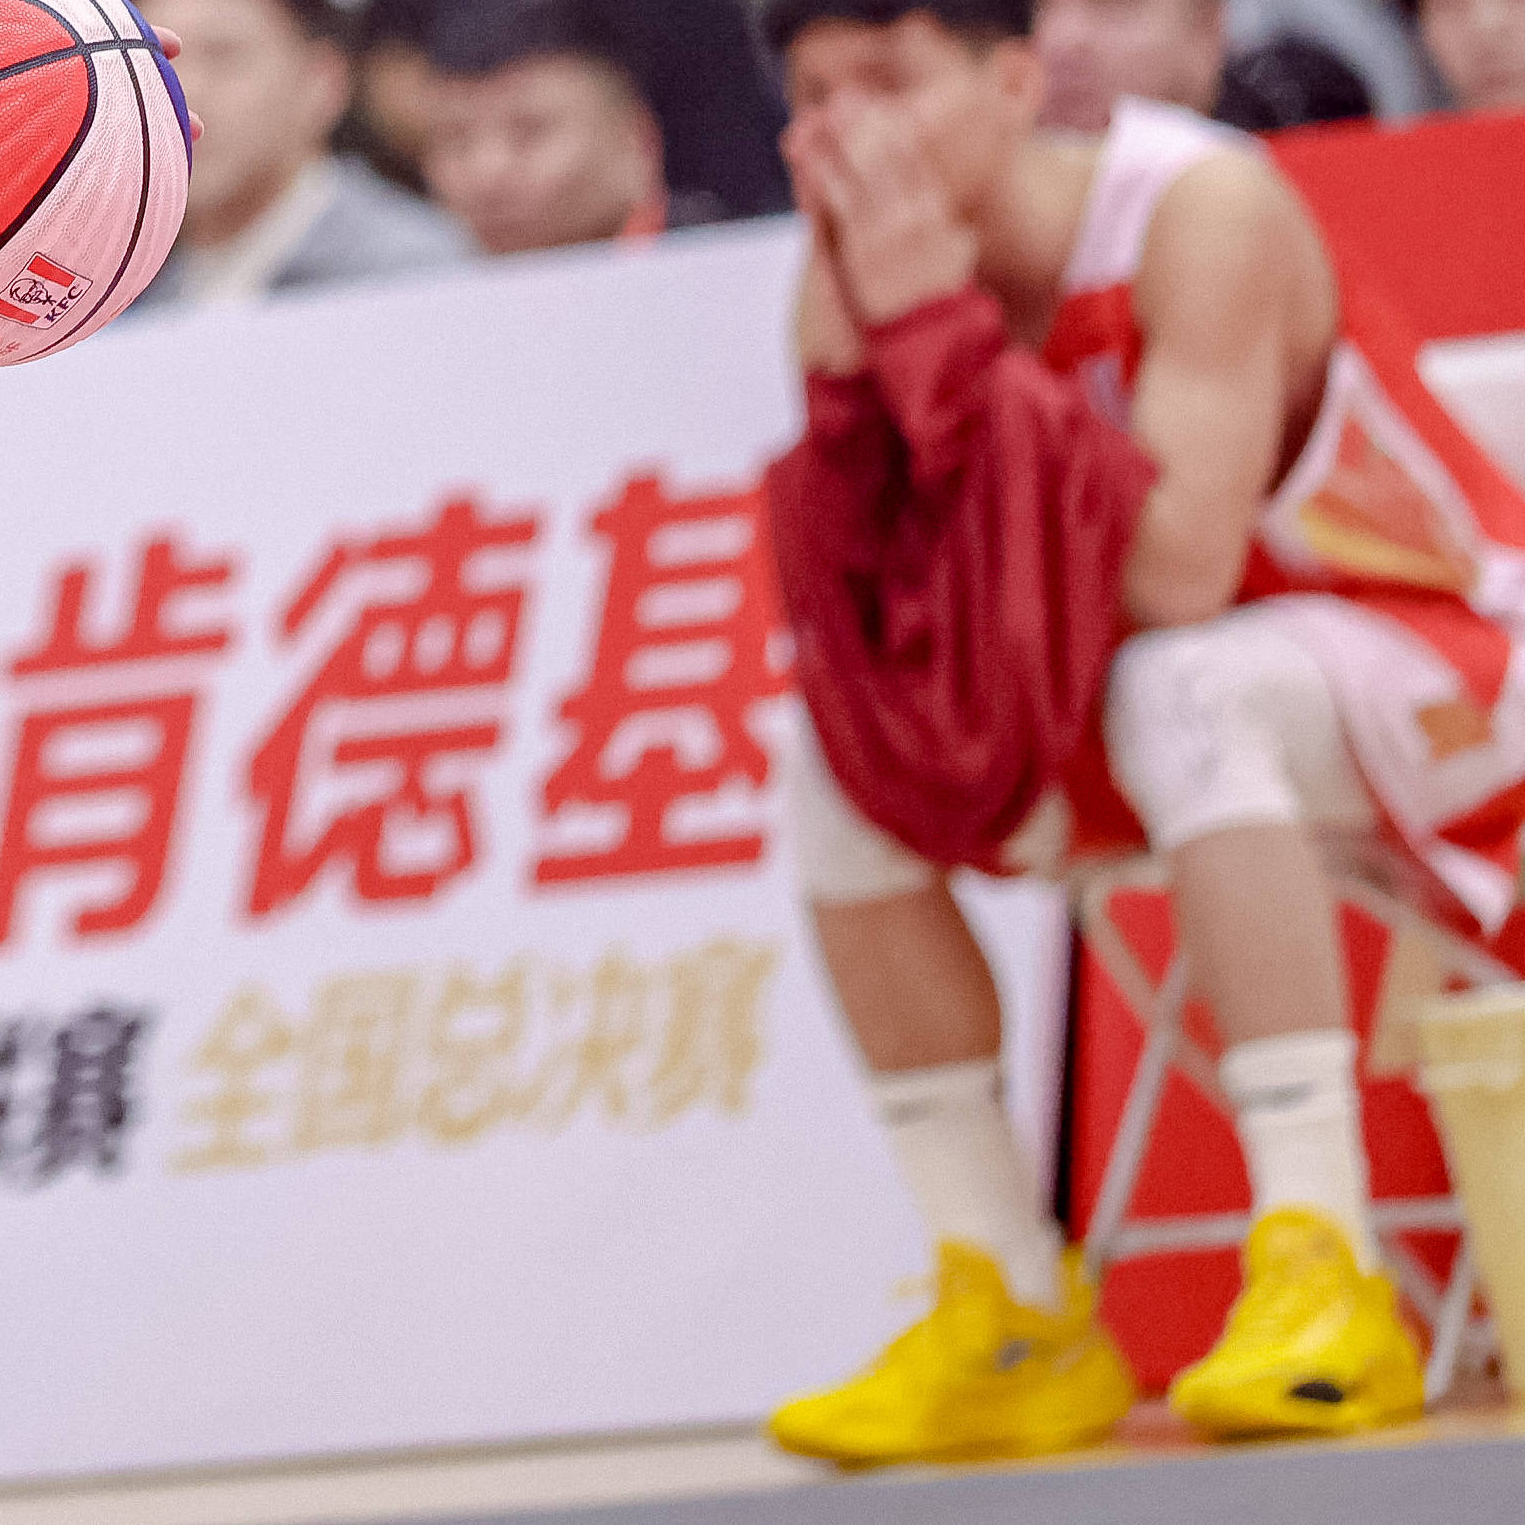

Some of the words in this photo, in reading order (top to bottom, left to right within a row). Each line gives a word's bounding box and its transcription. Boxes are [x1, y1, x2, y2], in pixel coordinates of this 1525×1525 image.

[43, 284, 84, 323] KFC
[164, 934, 781, 1176] 全国总决赛
